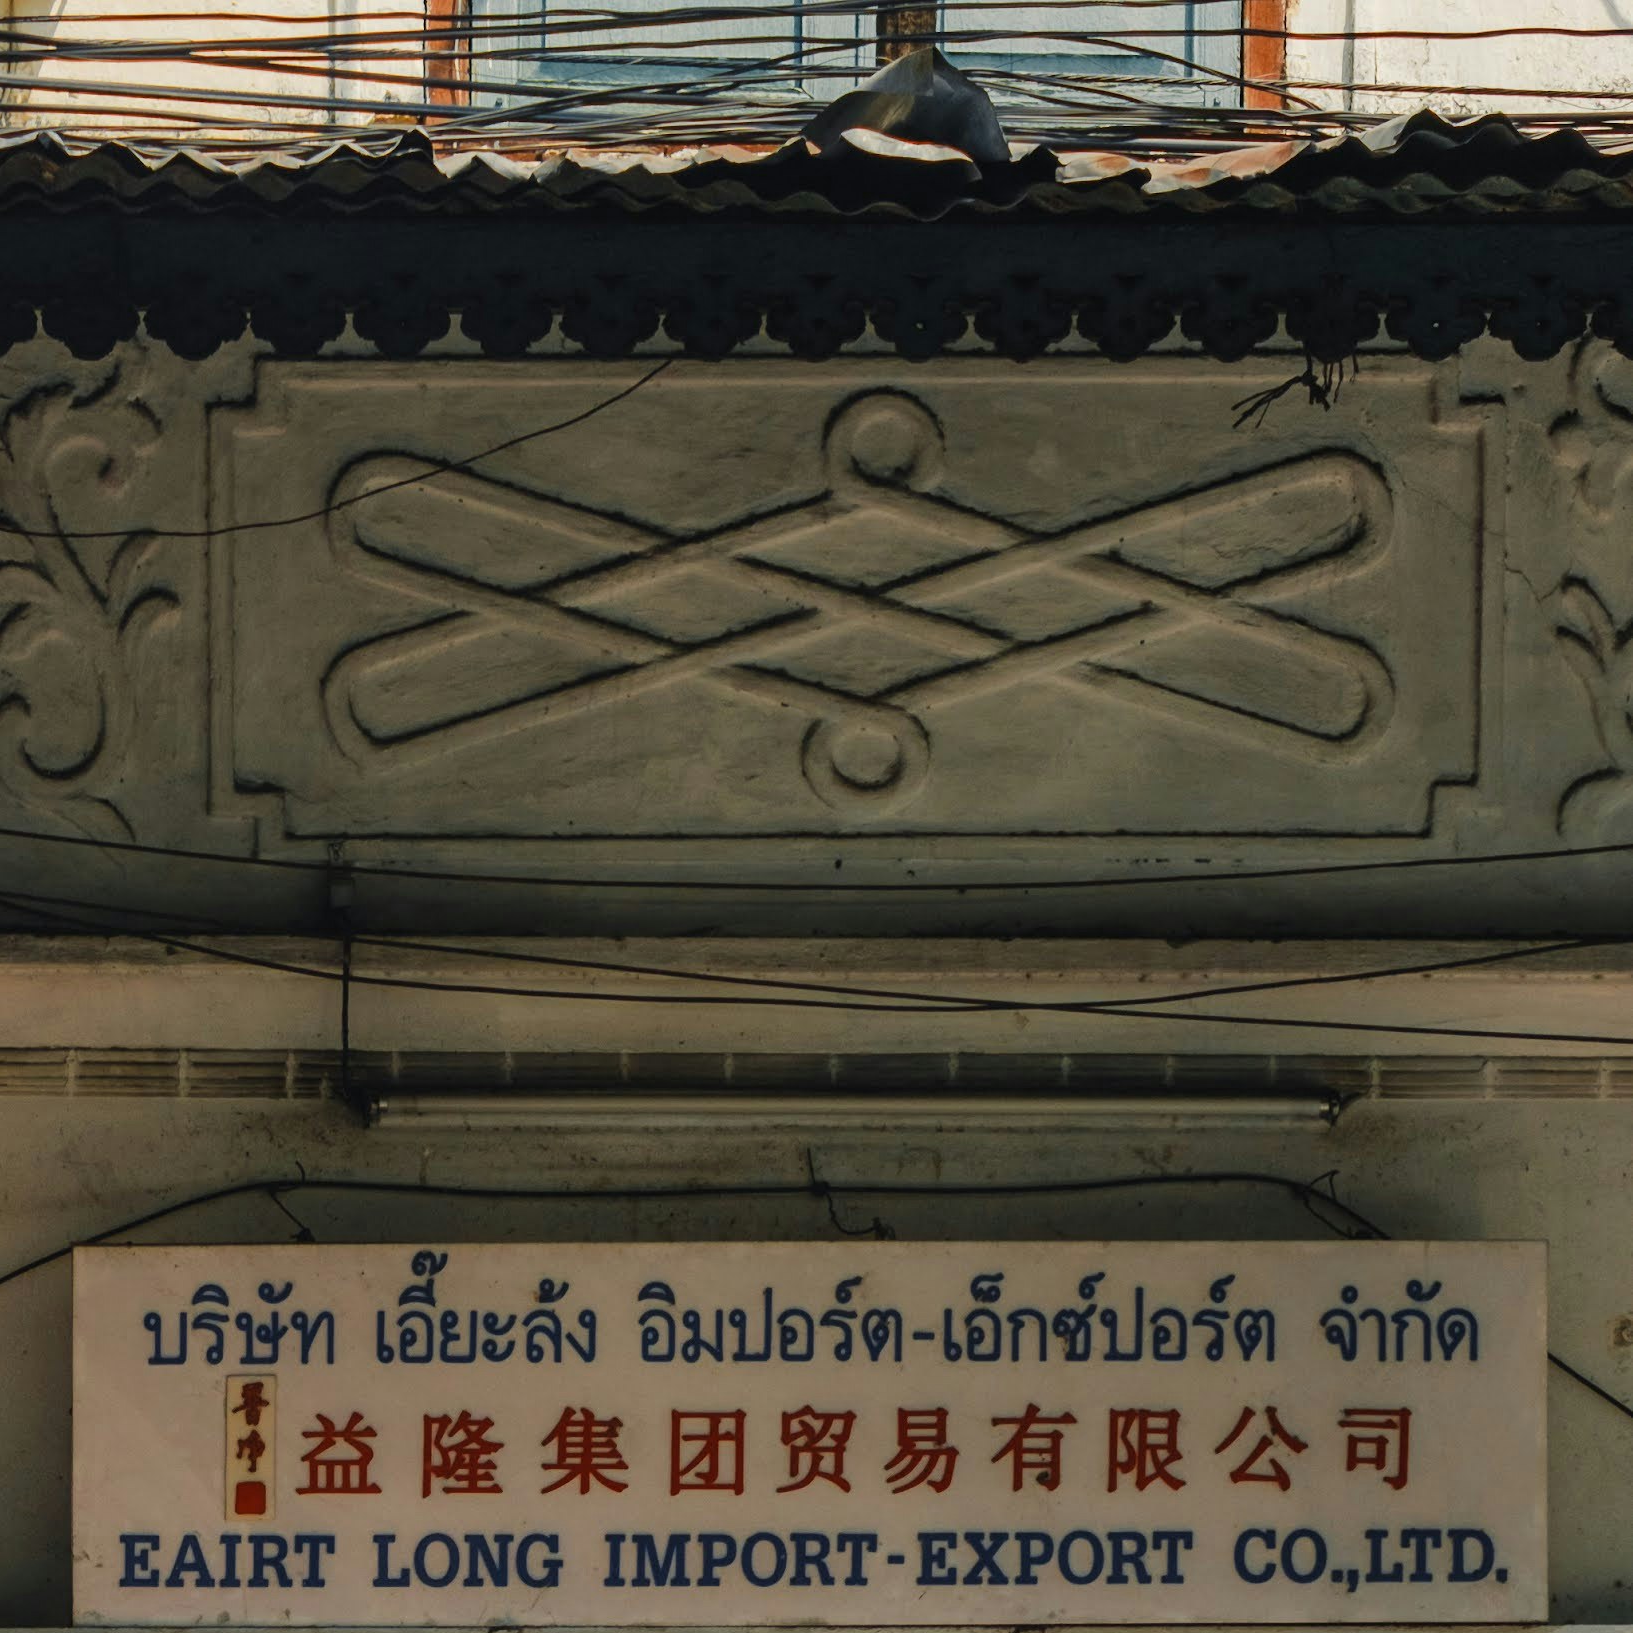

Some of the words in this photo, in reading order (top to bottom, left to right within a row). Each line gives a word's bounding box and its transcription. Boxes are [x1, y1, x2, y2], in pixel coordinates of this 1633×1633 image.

[143, 1282, 334, 1365] บริษัท
[376, 1250, 597, 1364] เอี๊ยะล้ง
[638, 1273, 1275, 1362] อิมปอร์ต-เอ็กซ์ปอร์ต
[1320, 1280, 1479, 1361] จำกัด
[296, 1402, 1412, 1498] 益隆集团贸易有限公司
[119, 1534, 335, 1588] EAIRT
[373, 1533, 564, 1588] LONG
[603, 1530, 1193, 1588] IMPORT-EXPORT
[1233, 1528, 1508, 1592] CO.,LTD.
